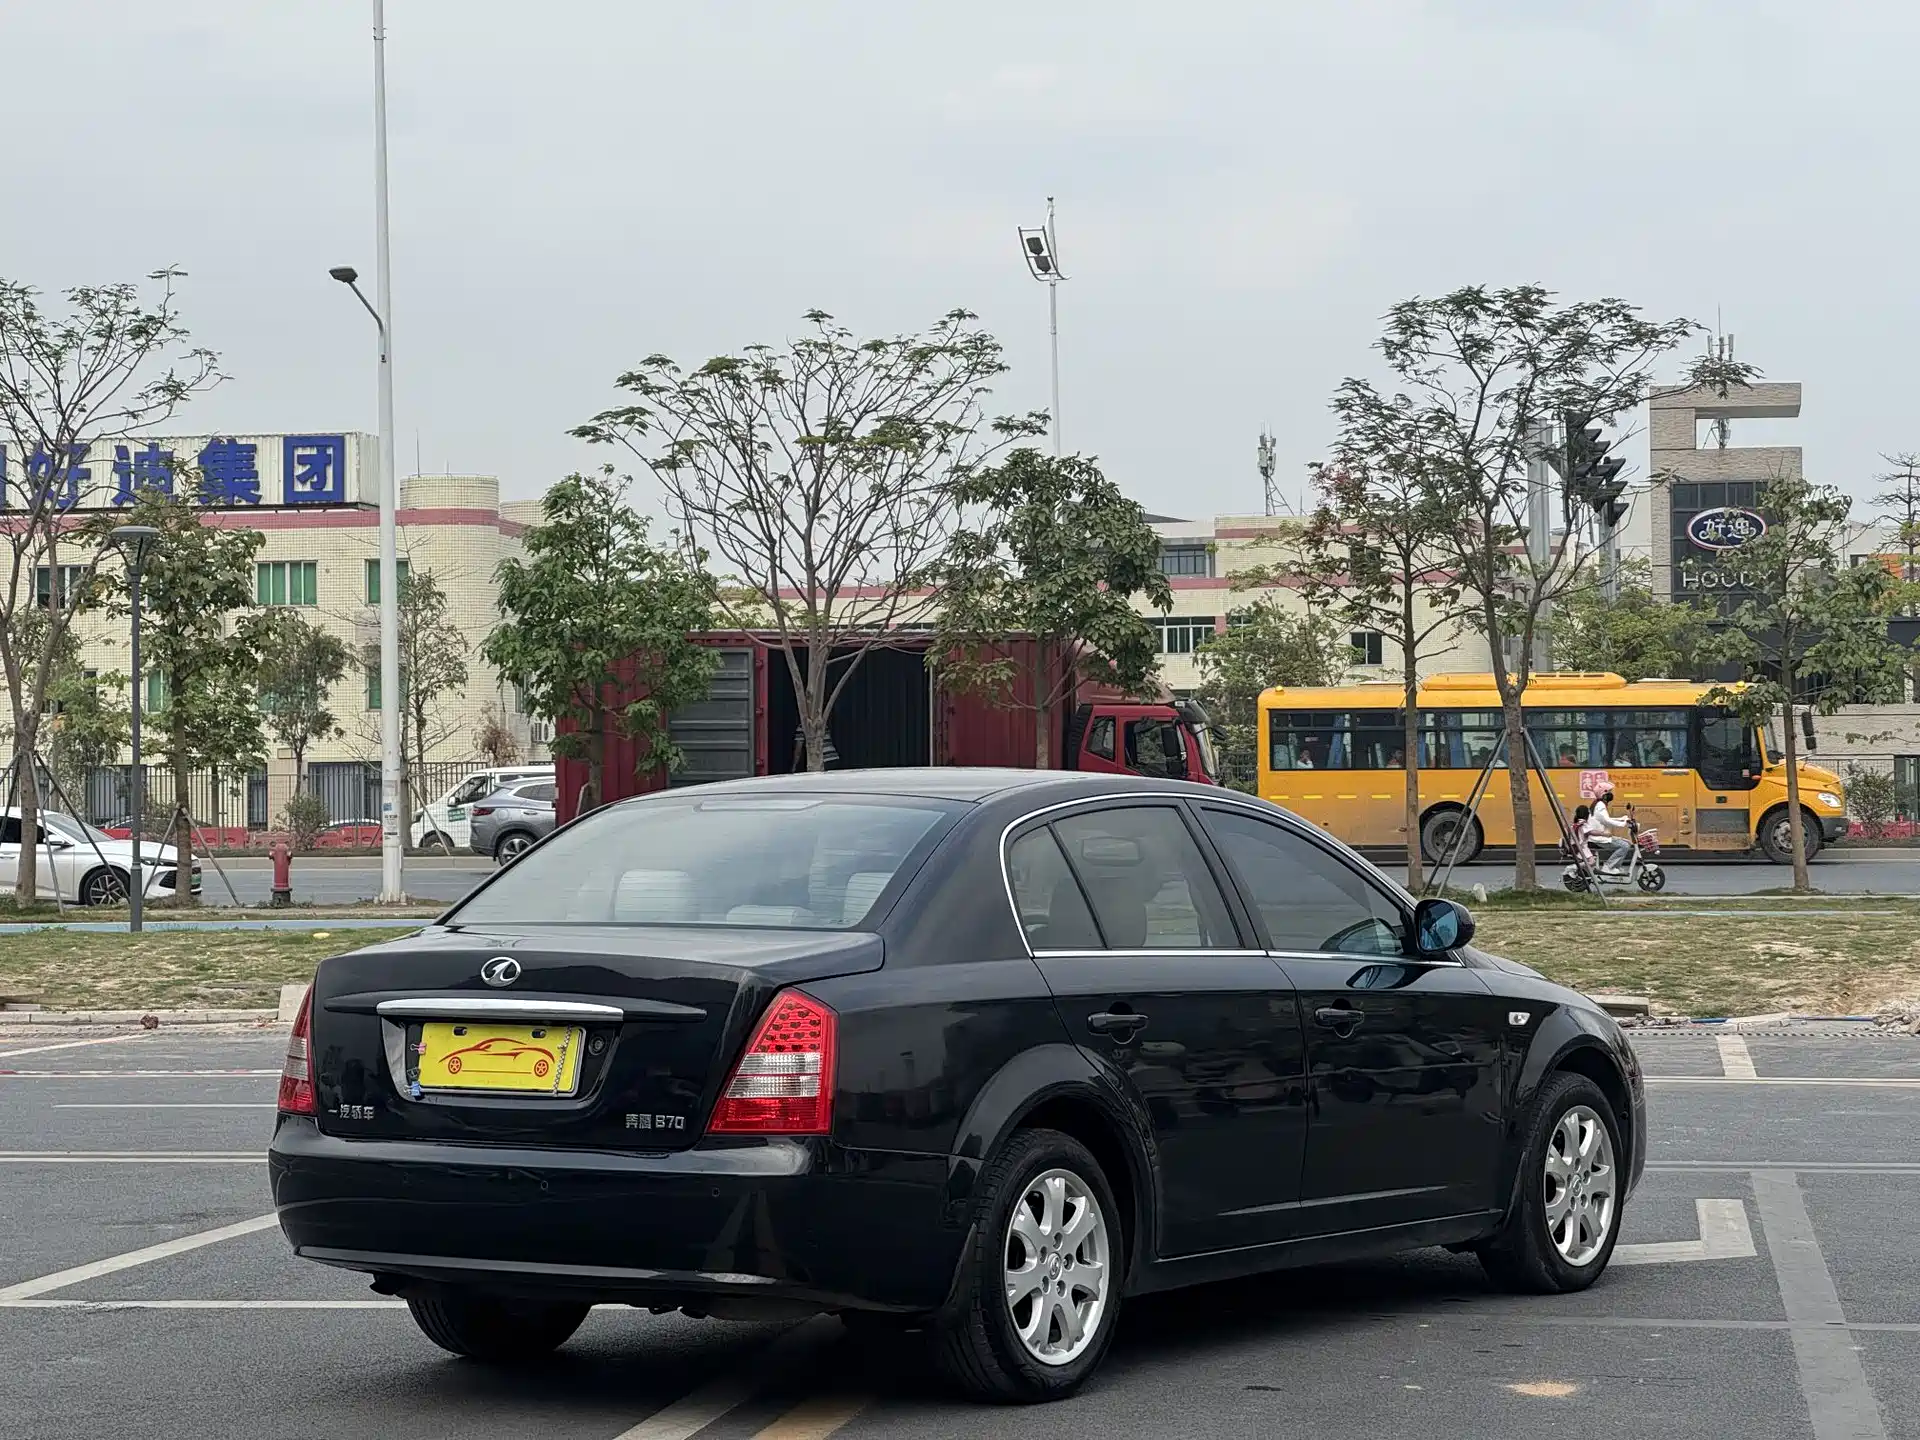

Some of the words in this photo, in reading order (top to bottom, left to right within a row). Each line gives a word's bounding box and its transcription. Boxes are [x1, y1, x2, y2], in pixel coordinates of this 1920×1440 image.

[0, 436, 346, 507] 好迪集团
[1699, 517, 1758, 540] 好迪
[328, 1104, 375, 1120] 一汽轿车
[655, 1114, 685, 1129] B70
